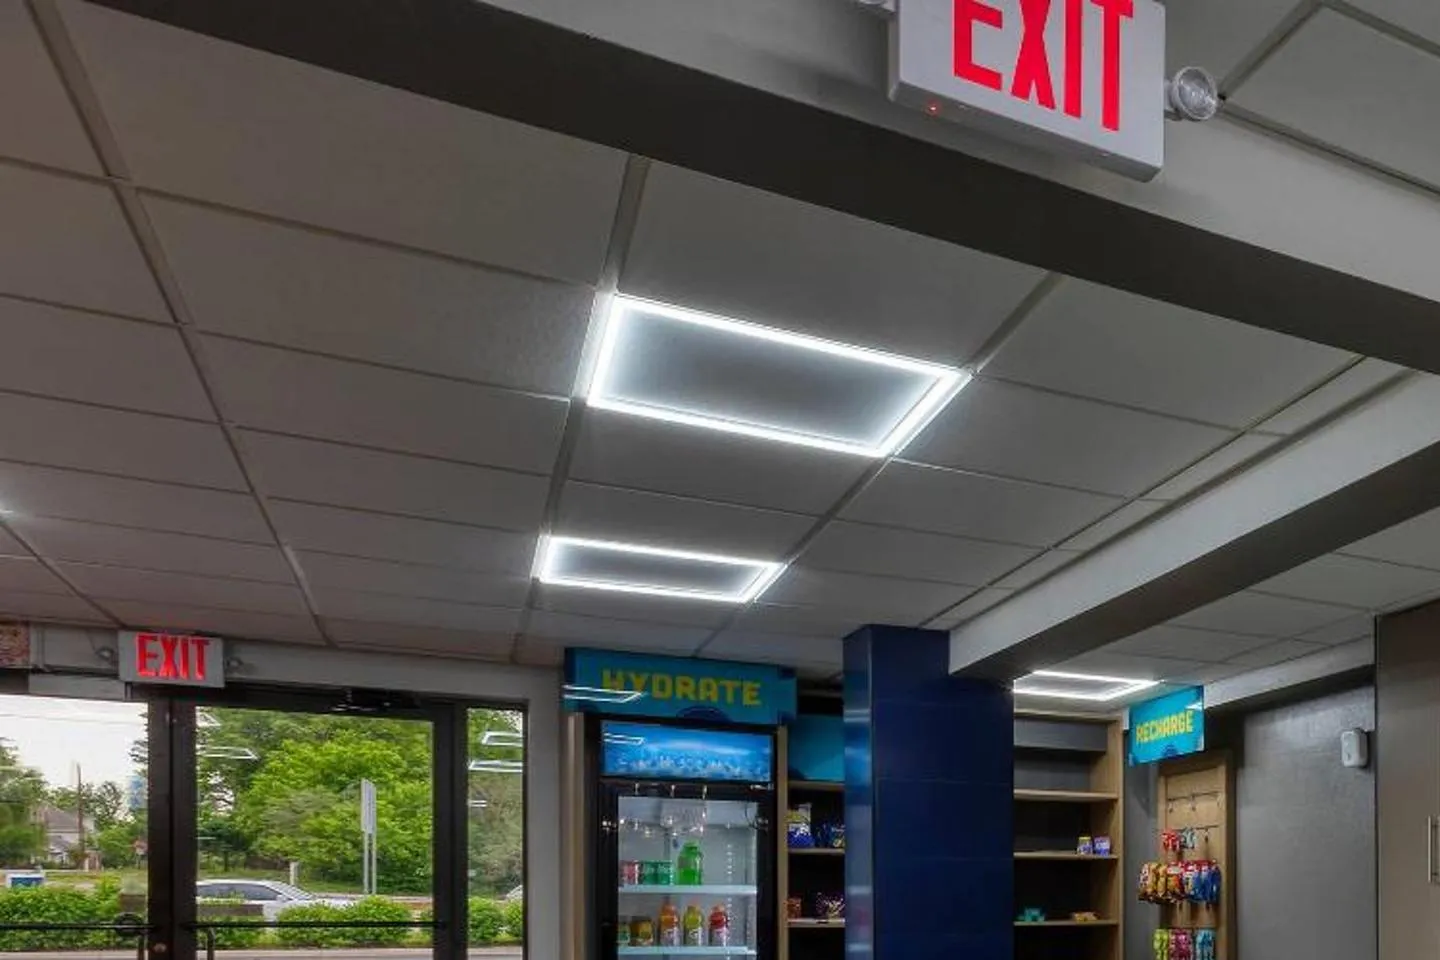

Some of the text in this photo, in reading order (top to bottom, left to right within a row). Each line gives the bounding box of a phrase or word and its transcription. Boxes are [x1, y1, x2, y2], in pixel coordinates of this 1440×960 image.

[953, 0, 1133, 131] EXIT
[136, 632, 212, 681] EXIT
[603, 669, 762, 706] HYDRATE
[1136, 708, 1194, 744] RECHARGE
